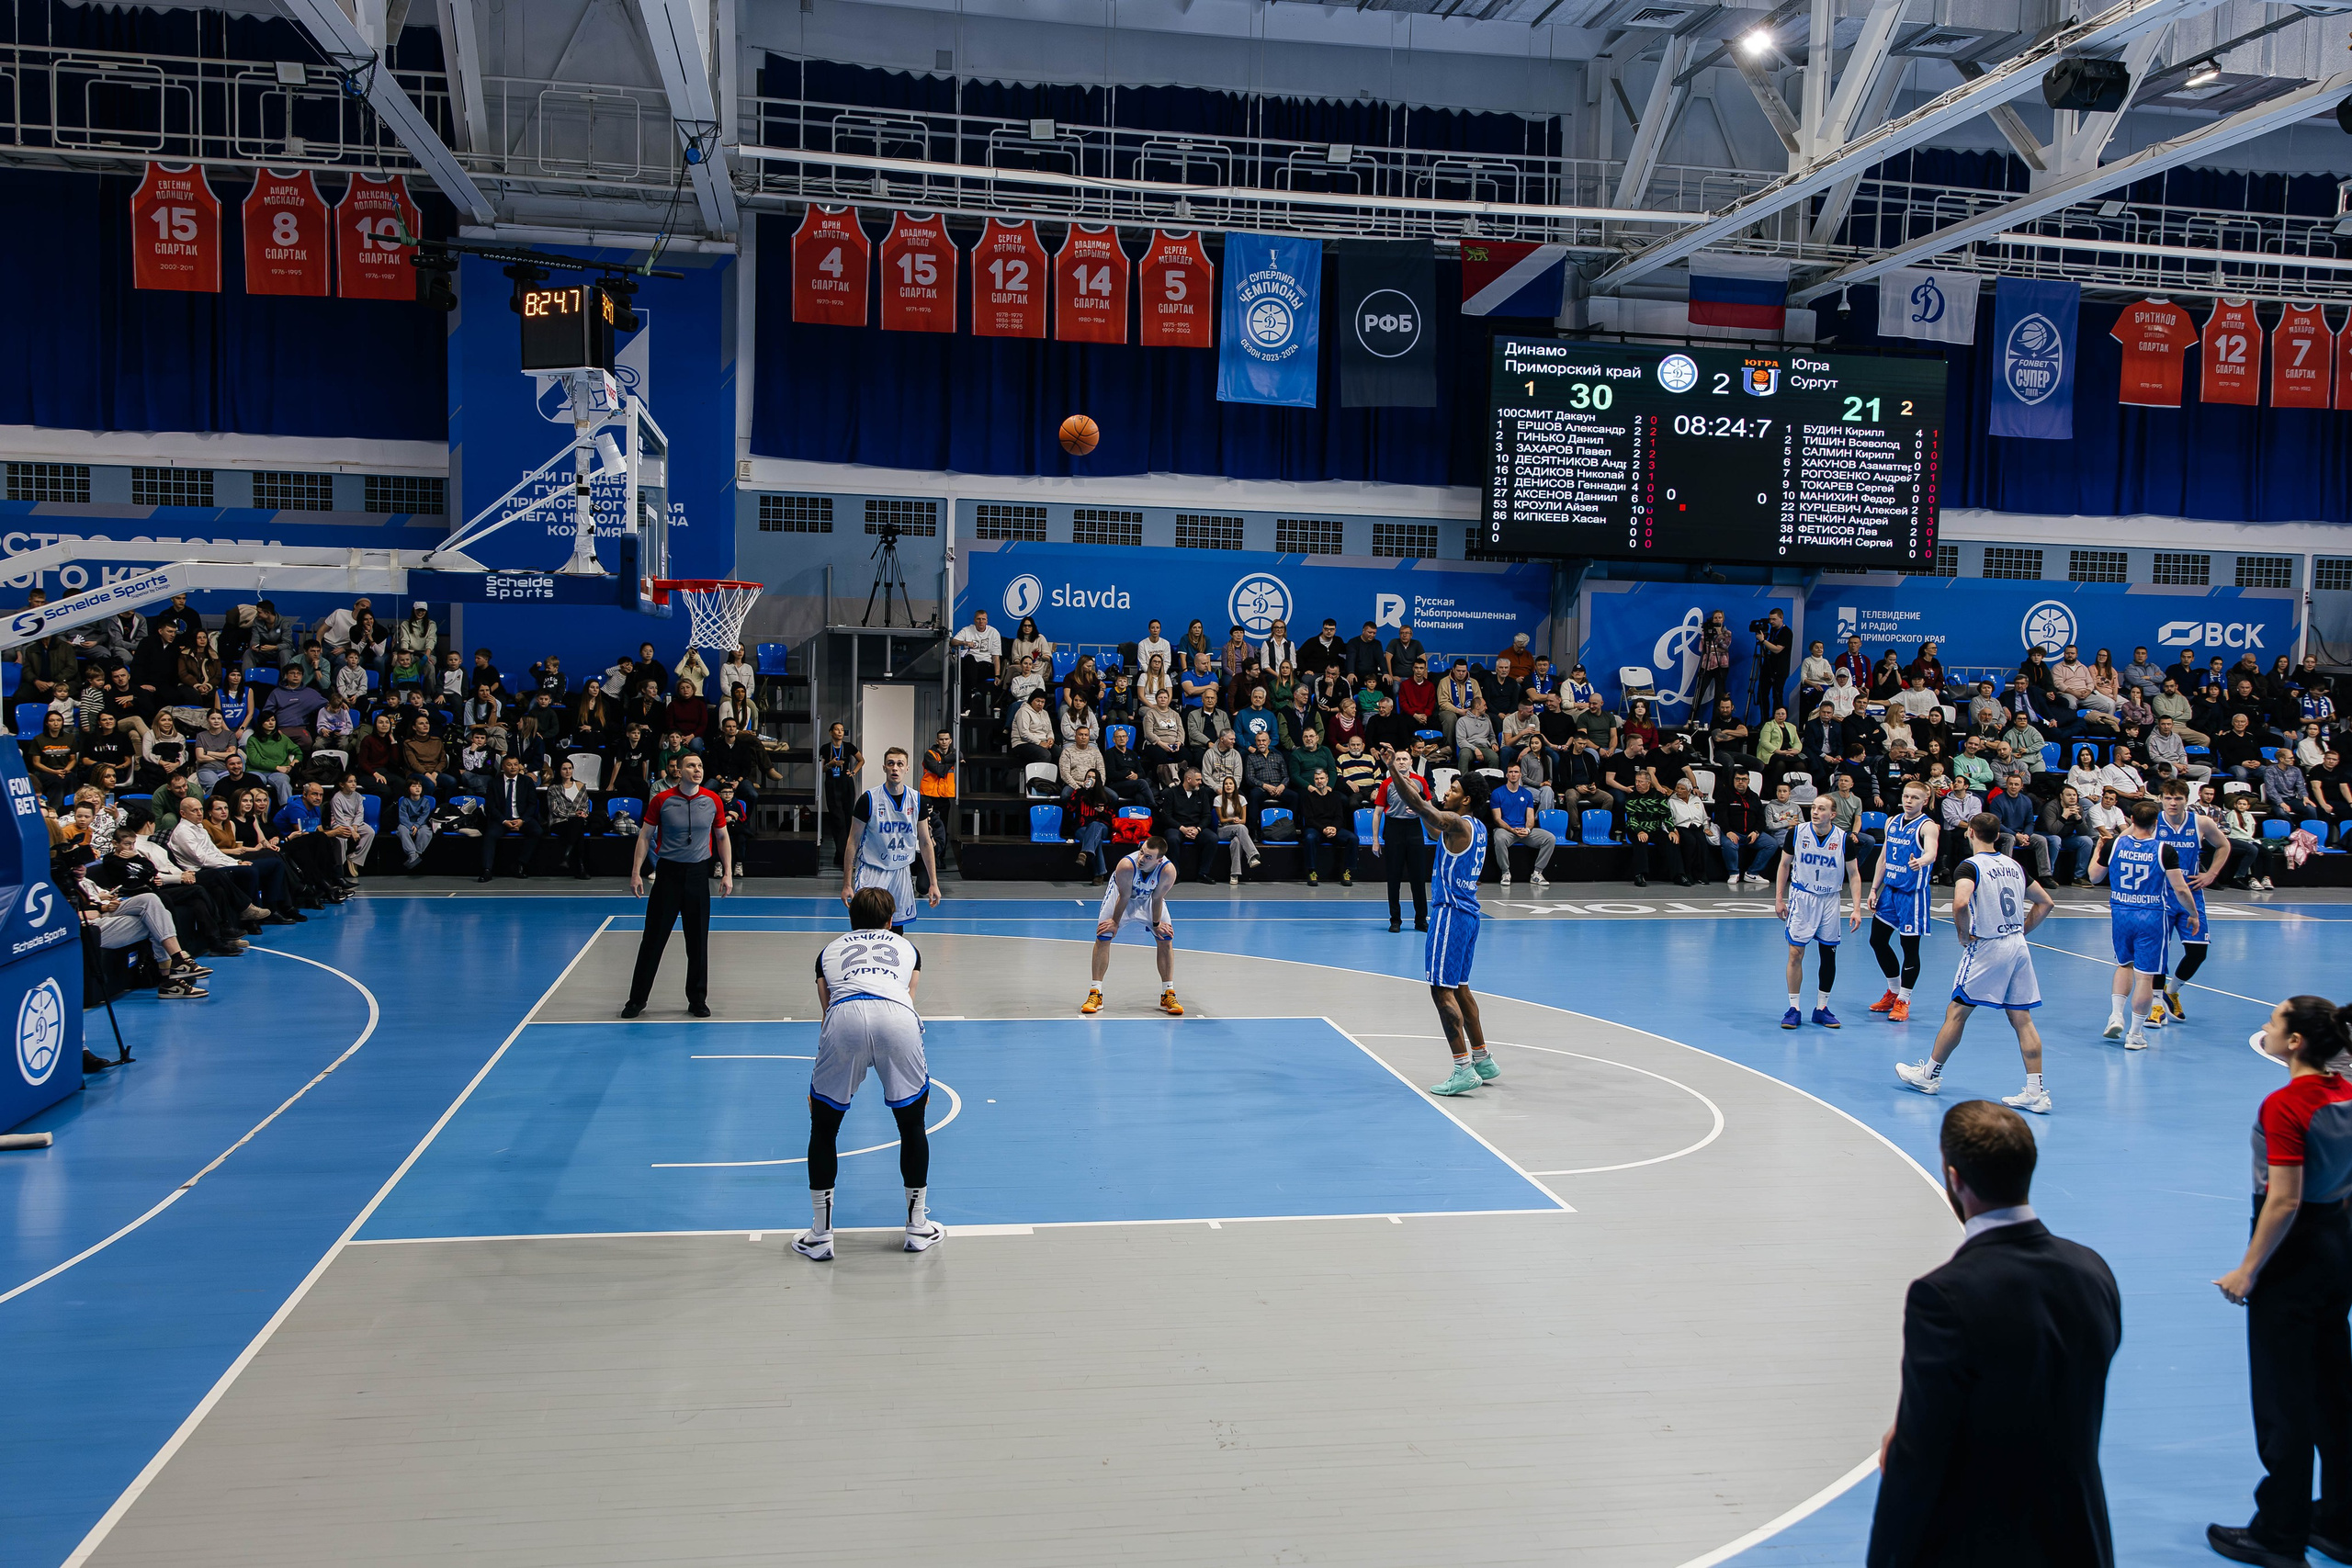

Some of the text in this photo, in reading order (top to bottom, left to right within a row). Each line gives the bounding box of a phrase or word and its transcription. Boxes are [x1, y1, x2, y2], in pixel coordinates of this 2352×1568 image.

[151, 207, 198, 241] 15
[273, 211, 300, 246] 8
[814, 230, 850, 241] КАПУСТИН
[900, 229, 936, 238] ВЛАДИМИР
[998, 234, 1022, 243] СЕРГЕЙ
[155, 243, 198, 256] СПАРТАК
[994, 243, 1025, 254] ЯРЕМЧУК
[1075, 240, 1110, 250] ВЛАДИМИР
[1164, 245, 1187, 254] СЕРГЕЙ
[266, 248, 308, 261] СПАРТАК
[359, 252, 400, 265] СПАРТАК
[819, 247, 842, 277] 4
[897, 253, 937, 285] 15
[989, 259, 1028, 290] 12
[812, 279, 849, 292] СПАРТАК
[1072, 265, 1112, 296] 14
[1165, 270, 1187, 300] 5
[1250, 271, 1295, 287] СУПЕРЛИГА
[900, 287, 937, 299] СПАРТАК
[992, 292, 1028, 304] СПАРТАК
[1238, 281, 1304, 310] ЧЕМПИОНЫ
[1074, 298, 1110, 310] СПАРТАК
[1159, 303, 1193, 314] СПАРТАК
[1364, 314, 1413, 332] РФБ
[2135, 312, 2176, 326] БРИТИКОВ
[1240, 338, 1299, 361] СЕЗОН 2023-2024
[1505, 342, 1566, 356] Динамо
[2139, 342, 2168, 353] СПАРТАК
[2215, 334, 2246, 363] 12
[2292, 340, 2312, 367] 7
[1505, 360, 1642, 379] Приморский край
[1792, 358, 1829, 371] Югра
[2018, 359, 2049, 367] FONBET
[2216, 365, 2245, 376] СПАРТАК
[2286, 369, 2315, 379] СПАРТАК
[1713, 373, 1730, 394] 2
[1791, 376, 1838, 390] Сургут
[2016, 369, 2050, 388] СУПЕР
[1525, 381, 1612, 410] 1 30
[2025, 389, 2038, 397] ЛИГА
[1842, 396, 1913, 422] 21 2
[1555, 411, 1595, 423] Дакаун
[1517, 421, 1625, 435] ЕРШОВ Александр
[1674, 415, 1771, 438] 08:24:7
[1804, 425, 1884, 437] БУДИН Кирилл
[1517, 432, 1603, 446] ГИНЬКО Данил
[1804, 436, 1900, 450] ТИШИН Всеволод
[1516, 443, 1611, 457] ЗАХАРОВ Павел
[1803, 447, 1894, 460] САЛМИН Кирилл
[1496, 454, 1599, 468] 10 ДЕСЯТНИКОВ
[1802, 459, 1856, 469] ХАКУНОВ
[1495, 466, 1624, 479] 16 САДИКОВ Николай
[1802, 469, 1871, 480] РОГОЗЕНКО
[1494, 477, 1574, 490] 21 ДЕНИСОВ
[1801, 481, 1894, 494] ТОКАРЕВ Сергей
[1494, 489, 1617, 502] 27 АКСЕНОВ Даниил
[1782, 491, 1895, 504] 10 МАНИХИН Федор
[1493, 500, 1645, 514] 53 КРОУЛИ Айзея 10
[1781, 502, 1908, 515] 22 КУРЦЕВИЧ Алексей
[1493, 512, 1606, 524] 86 КИПКЕЕВ Хасан
[1781, 513, 1888, 526] 23 ПЕЧКИН Андрей
[1781, 525, 1877, 536] 38 ФЕТИСОВ Лев
[1780, 536, 1893, 548] 44 ГРАШКИН Сергей
[486, 576, 553, 587] Schelde
[44, 593, 111, 620] Schelde
[113, 574, 168, 597] Sports
[130, 590, 149, 599] Superior
[154, 583, 170, 592] Design
[486, 587, 553, 600] Sports
[1051, 583, 1130, 609] slavda
[1415, 596, 1454, 607] Русская
[1415, 607, 1516, 620] Рыбопромышленная
[1861, 611, 1920, 621] ТЕЛЕВИДЕНИЕ
[1414, 619, 1464, 629] Компания
[1870, 623, 1897, 631] РАДИО
[1861, 634, 1922, 642] ПРИМОРСКОГО
[2205, 623, 2265, 649] ВСК
[225, 709, 243, 717] 27
[8, 777, 31, 795] FON
[15, 796, 36, 816] BET
[888, 837, 905, 851] 44
[1801, 852, 1838, 868] ЮГРА
[1893, 847, 1897, 860] 2
[2119, 850, 2153, 862] АКСЕНОВ
[1815, 870, 1819, 881] 1
[1986, 867, 2018, 881] ХАКУНОВ
[2120, 862, 2149, 890] 27
[2000, 887, 2016, 918] 6
[13, 927, 66, 953] Schelde Sports
[844, 933, 894, 942] ПЕЧКИН
[841, 943, 899, 971] 23
[843, 967, 899, 981] СУРГУТ
